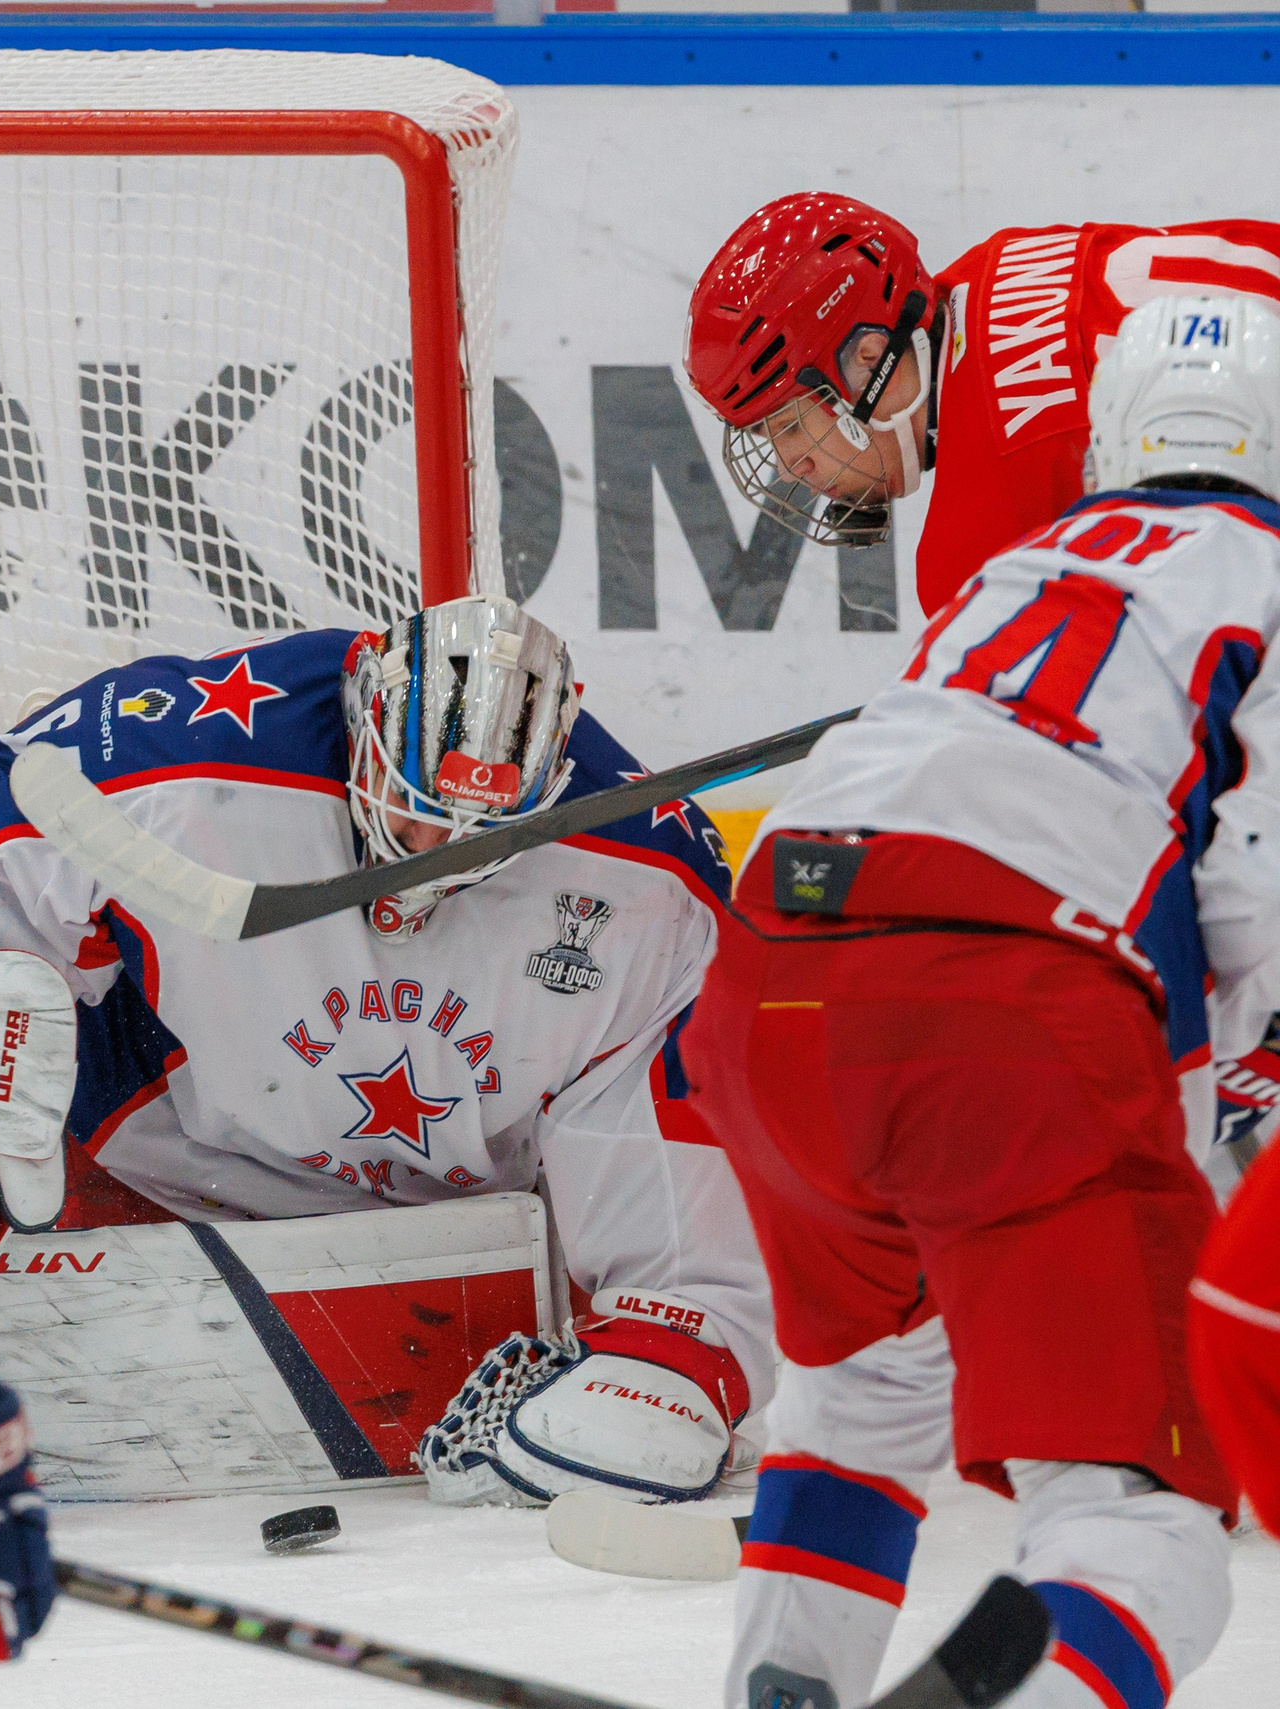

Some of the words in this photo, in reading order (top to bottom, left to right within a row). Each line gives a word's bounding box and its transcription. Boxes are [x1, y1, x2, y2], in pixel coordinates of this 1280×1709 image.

[816, 274, 855, 320] CCM
[1182, 314, 1223, 347] 74
[100, 681, 116, 762] РОСНЕФТЬ
[439, 778, 513, 804] OLIMPBET
[527, 956, 603, 992] ПЛЕЙ-ОФФ
[19, 1012, 31, 1045] PRO
[614, 1294, 706, 1328] ULTRA
[669, 1321, 701, 1337] PRO
